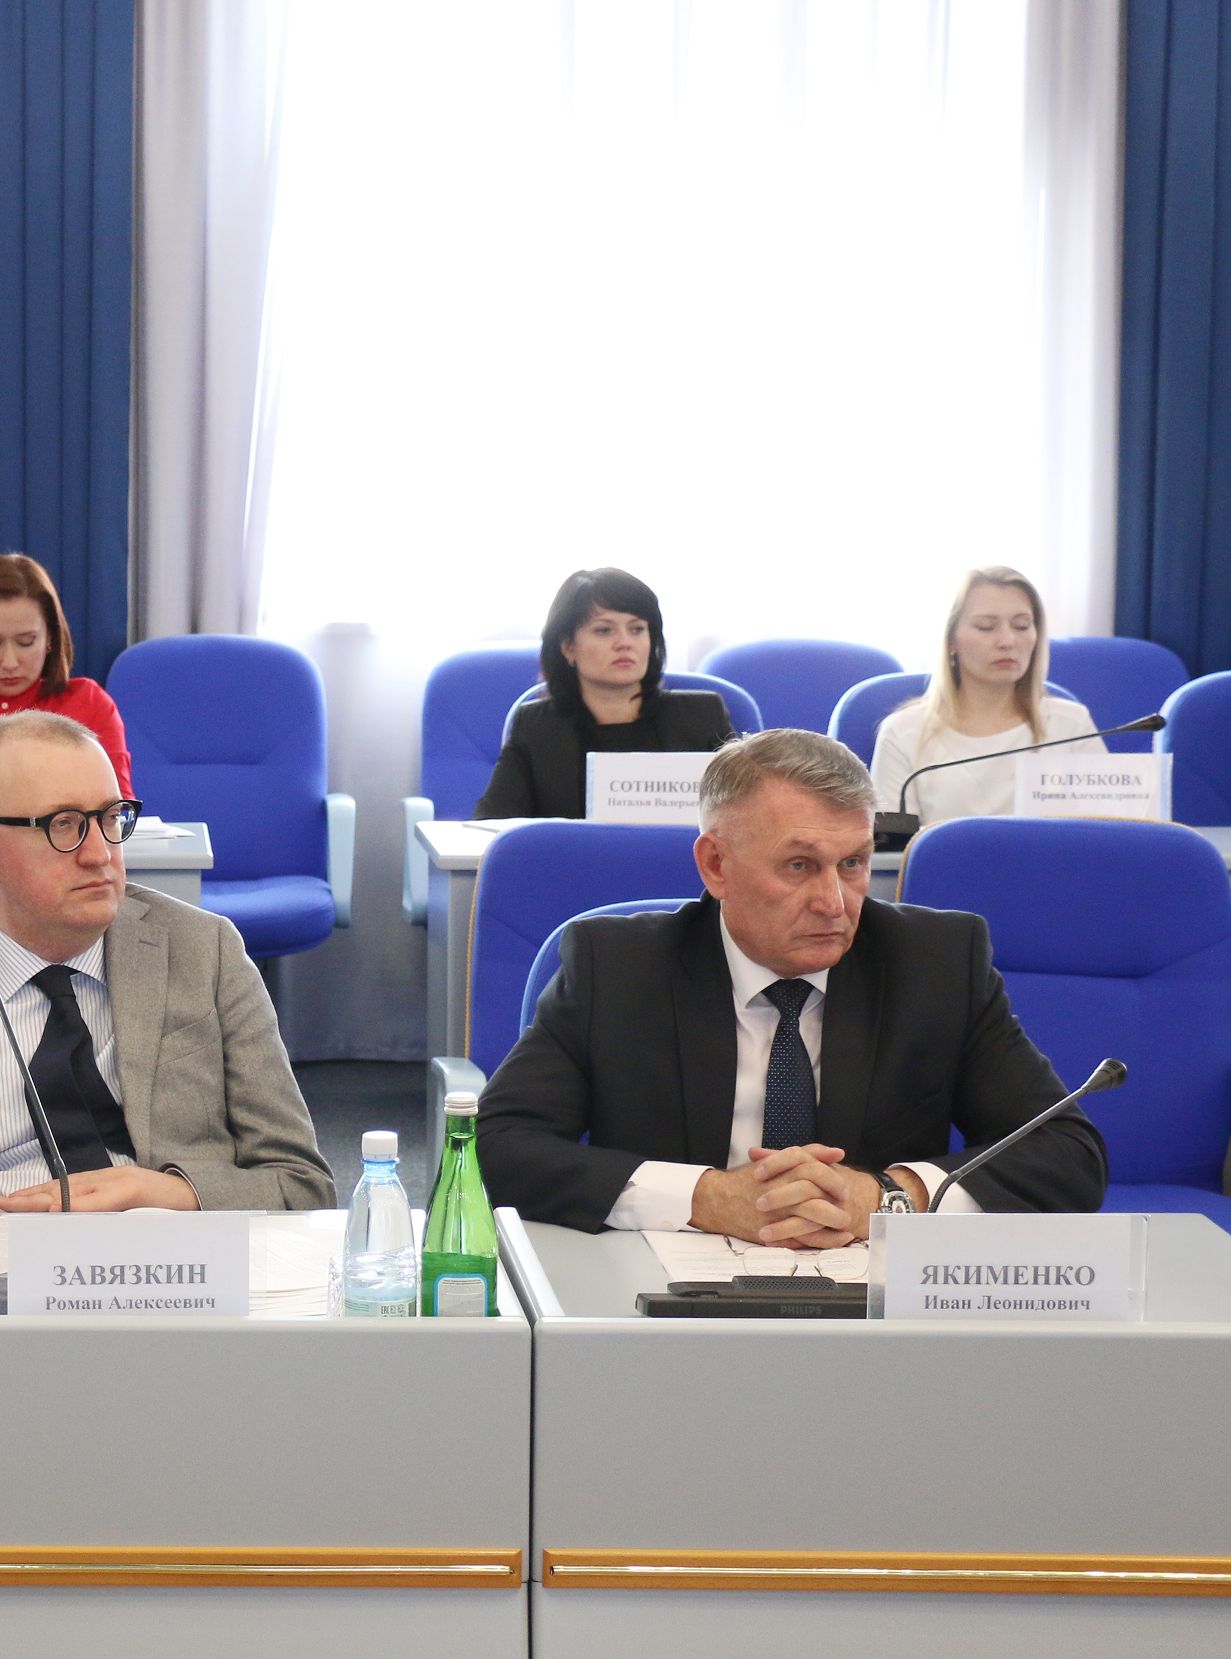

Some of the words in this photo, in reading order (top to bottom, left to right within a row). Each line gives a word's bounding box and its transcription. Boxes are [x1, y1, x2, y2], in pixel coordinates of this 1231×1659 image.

[609, 780, 700, 793] СОТНИКОВ
[1040, 774, 1143, 786] ГОЛУБКОВА
[53, 1263, 208, 1286] ЗАВЯЗКИН
[919, 1264, 1096, 1286] ЯКИМЕНКО
[45, 1296, 103, 1311] Роман
[108, 1296, 216, 1310] Алексеевич
[780, 1305, 823, 1315] PHILIPS
[923, 1295, 972, 1310] Иван
[977, 1295, 1091, 1311] Леонидович
